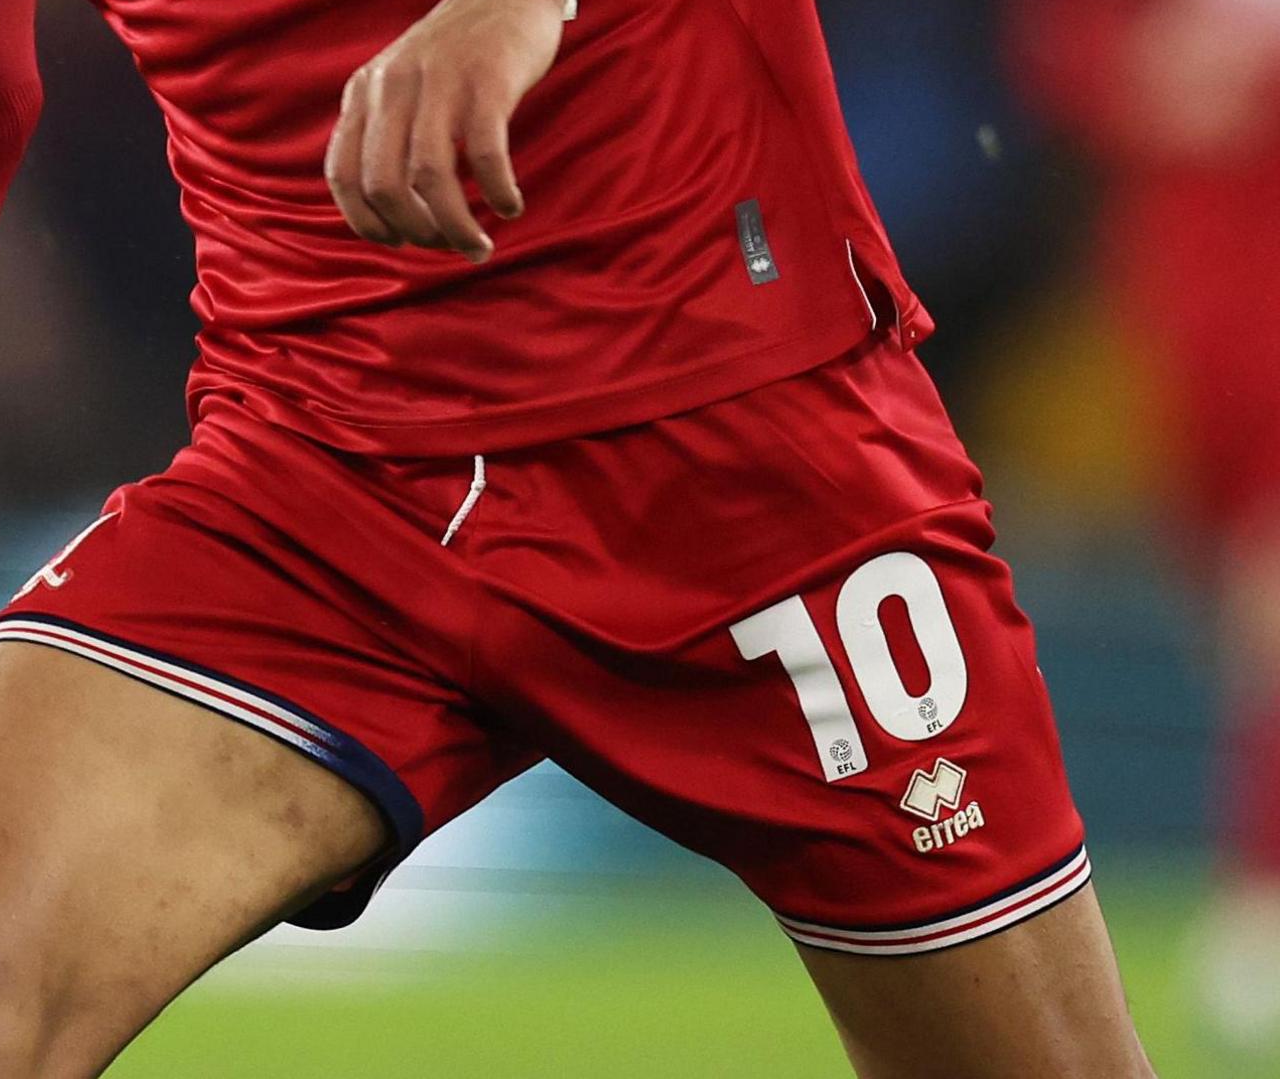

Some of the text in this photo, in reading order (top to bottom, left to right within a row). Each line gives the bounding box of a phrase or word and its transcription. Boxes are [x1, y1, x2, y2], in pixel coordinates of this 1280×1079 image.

[728, 551, 968, 783] 10
[926, 720, 944, 734] EFL
[836, 761, 857, 775] EFL
